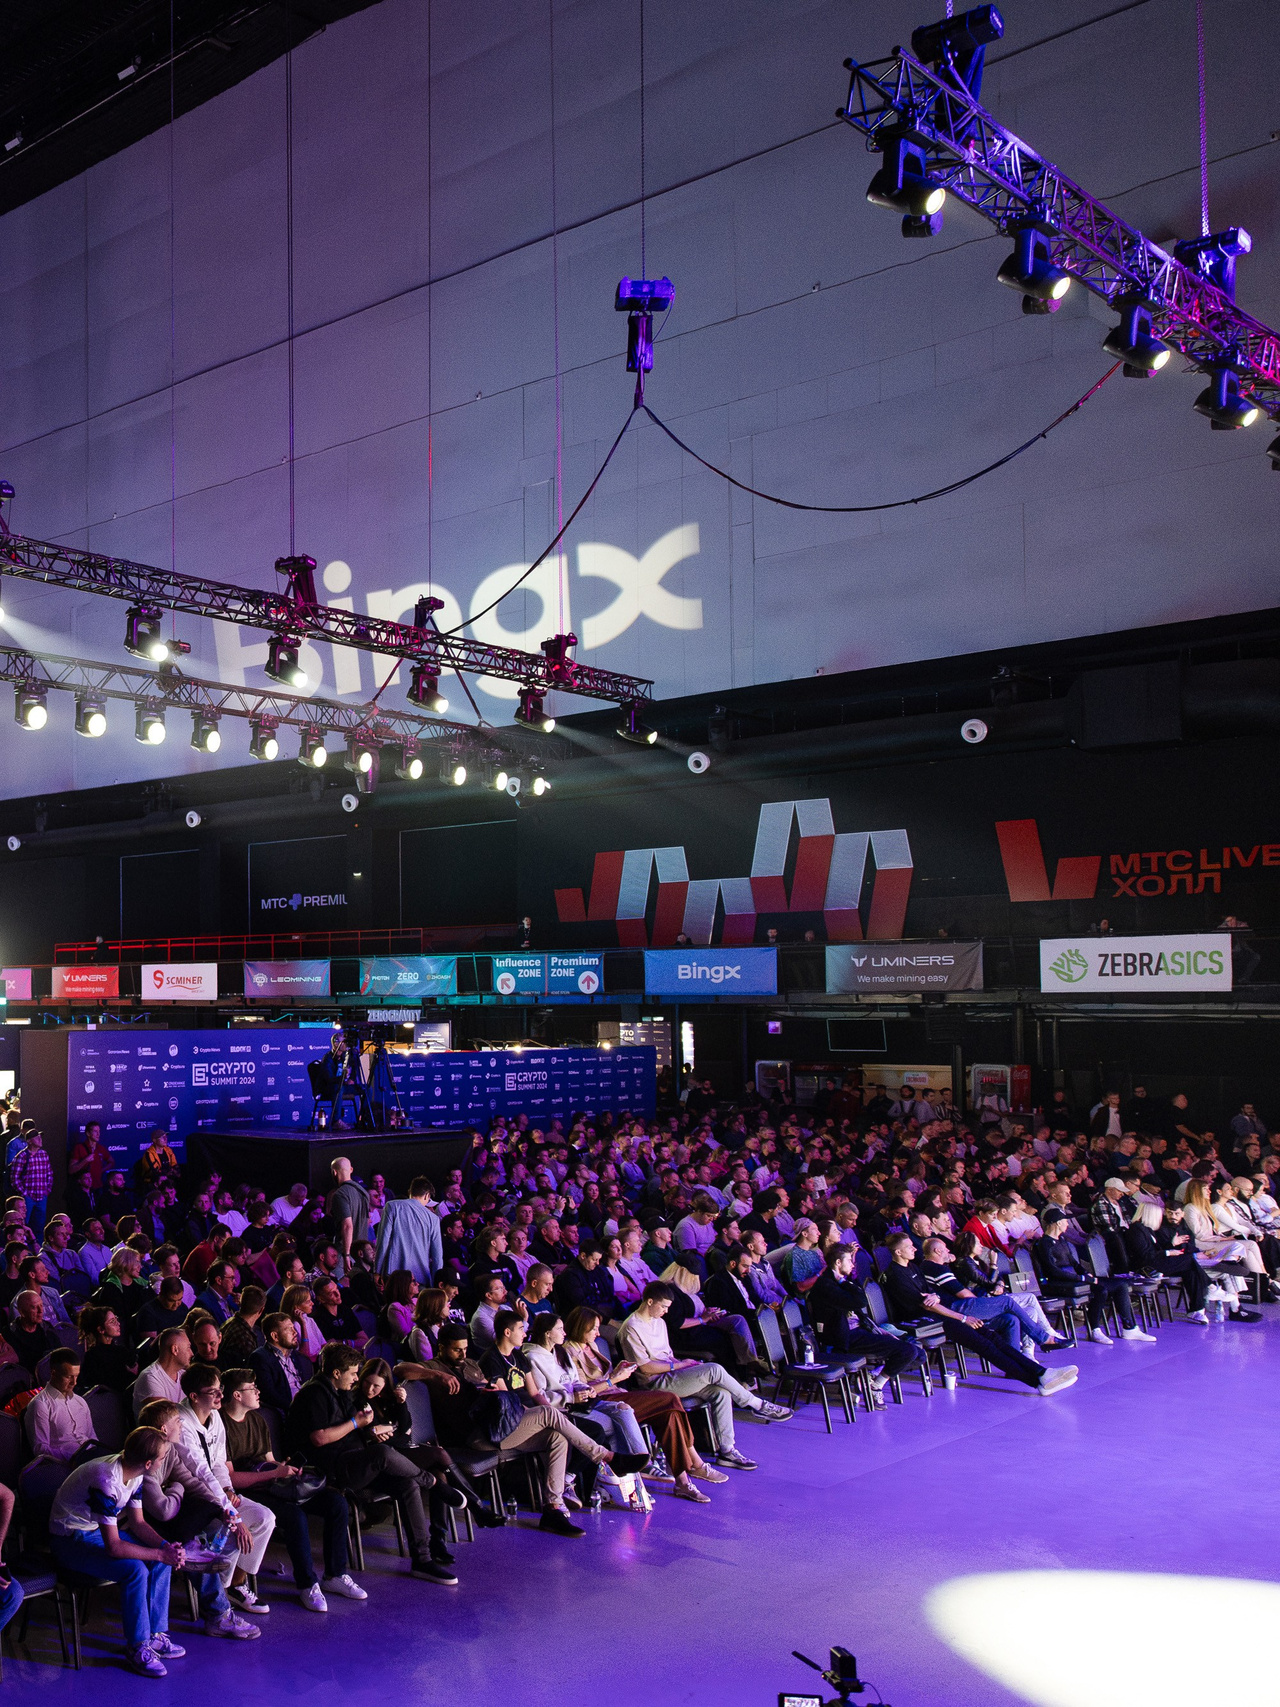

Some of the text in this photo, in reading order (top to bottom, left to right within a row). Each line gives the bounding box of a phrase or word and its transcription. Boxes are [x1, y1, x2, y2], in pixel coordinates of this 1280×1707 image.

[1199, 844, 1280, 870] LIVE
[1111, 872, 1221, 898] ХОЛЛ
[496, 957, 541, 967] Influence
[551, 956, 599, 966] Premium
[871, 955, 955, 967] UMINERS
[1098, 950, 1224, 977] ZEBRASICS
[397, 972, 419, 980] ZERO
[518, 969, 541, 977] ZONE
[551, 968, 575, 977] ZONE
[71, 974, 108, 982] UMINERS
[166, 976, 202, 985] SCMINER
[857, 973, 949, 984] We make mining easy
[210, 1062, 256, 1075] CRYPTO
[210, 1077, 256, 1086] SUMMIT 2024
[517, 1071, 548, 1082] CRYPTO
[517, 1083, 535, 1091] SUMMIT
